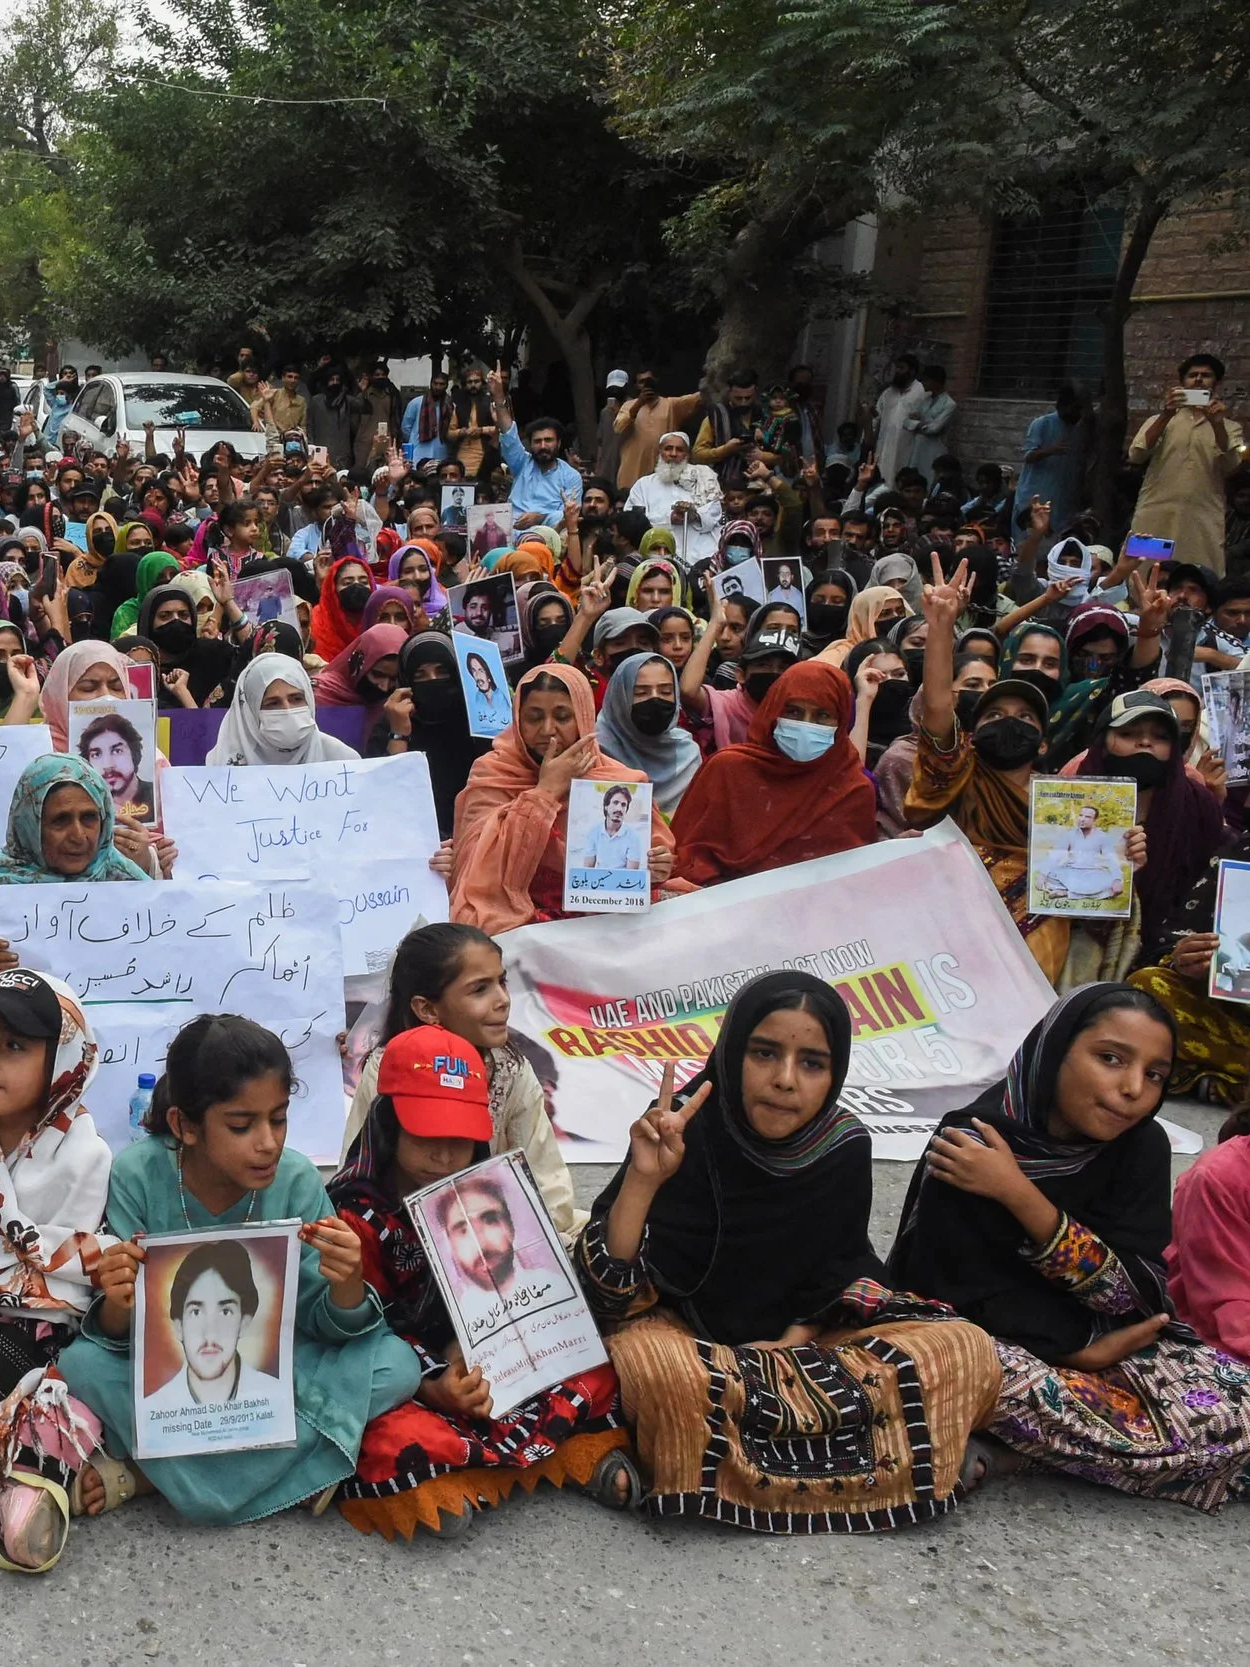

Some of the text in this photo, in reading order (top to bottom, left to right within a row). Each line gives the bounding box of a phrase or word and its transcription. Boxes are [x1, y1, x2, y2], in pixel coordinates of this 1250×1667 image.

[183, 763, 356, 805] We Want
[236, 810, 369, 863] Justice For
[571, 871, 646, 890] راشد حسین بلوچ
[570, 895, 645, 907] 26 December 2018
[78, 908, 177, 944] خلاف
[186, 904, 237, 938] کے
[247, 892, 295, 957] ظلم
[131, 972, 193, 995] راشد
[589, 998, 632, 1029] UAE
[633, 990, 678, 1024] AND
[821, 938, 876, 977] NOW
[547, 1022, 715, 1058] RASHID
[914, 951, 978, 1015] IS
[434, 1055, 469, 1077] FUN
[916, 1025, 964, 1077] 5
[150, 1397, 270, 1421] Zahoor Ahmad S/o Khair Bakhsh
[162, 1421, 192, 1434] missing
[194, 1419, 212, 1430] Date
[219, 1412, 254, 1426] 29/9/2013
